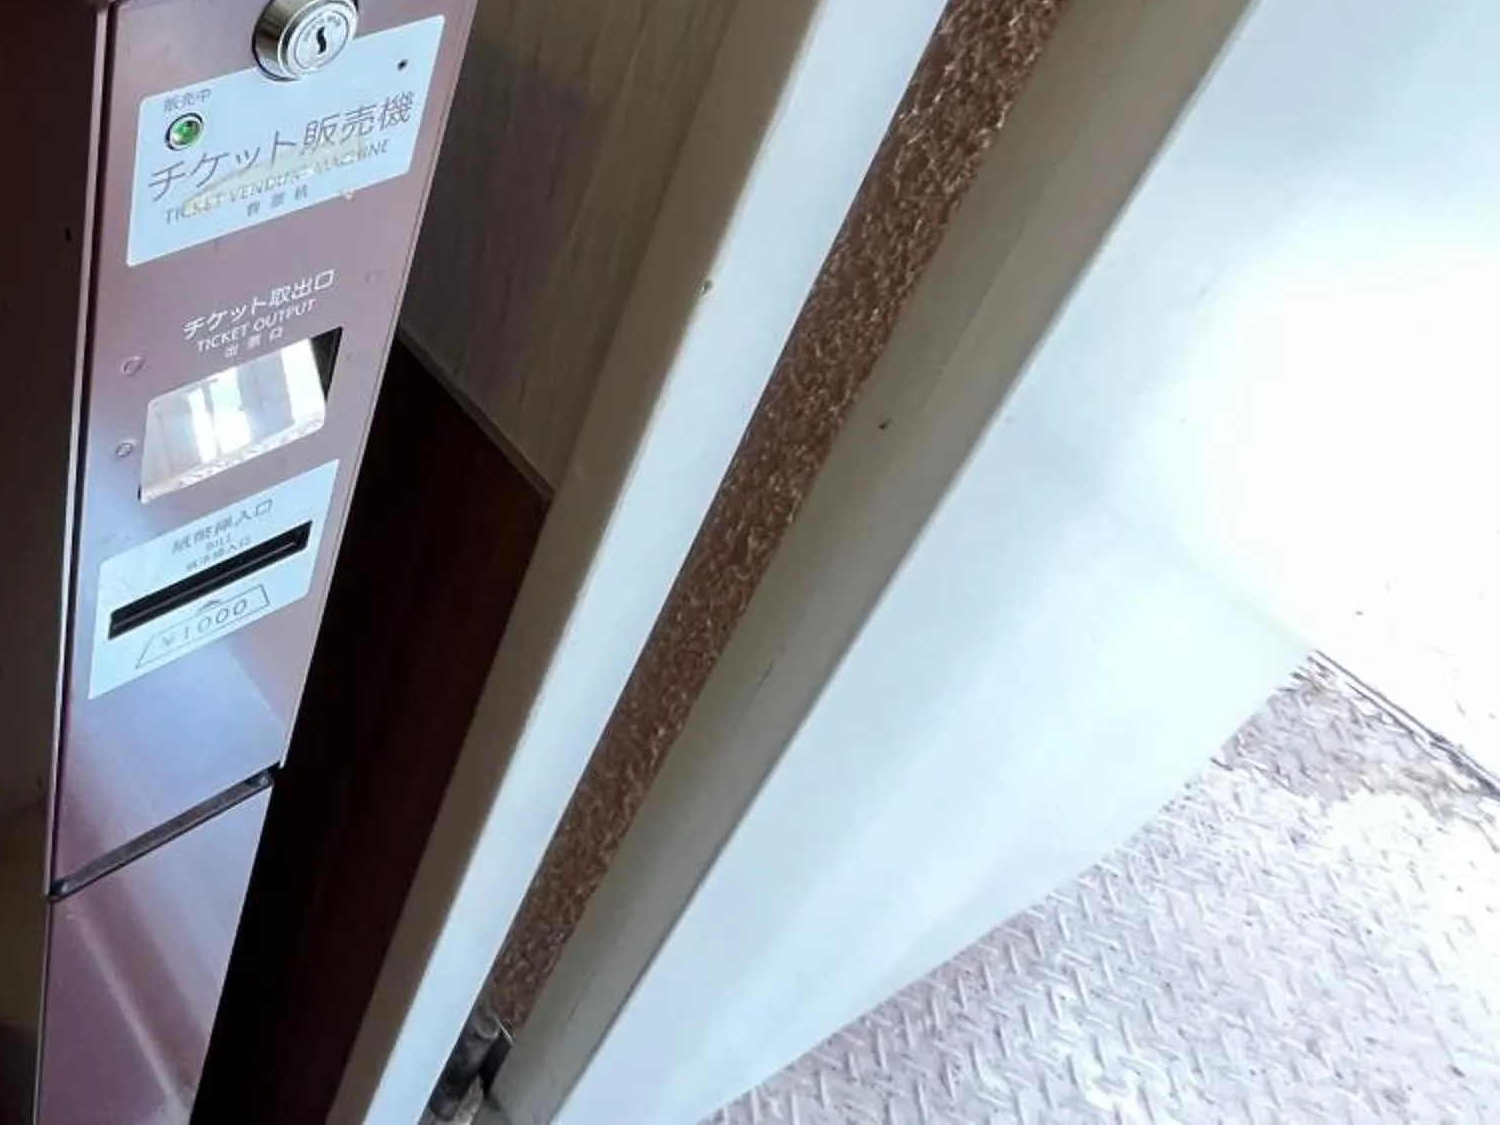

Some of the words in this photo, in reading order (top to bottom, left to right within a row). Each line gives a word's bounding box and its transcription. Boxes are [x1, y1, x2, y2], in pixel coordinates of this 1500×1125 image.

[148, 91, 415, 202] チケット販売機
[184, 269, 336, 340] チケット取出口
[198, 322, 249, 353] TICKET
[252, 298, 316, 332] OUTPUT
